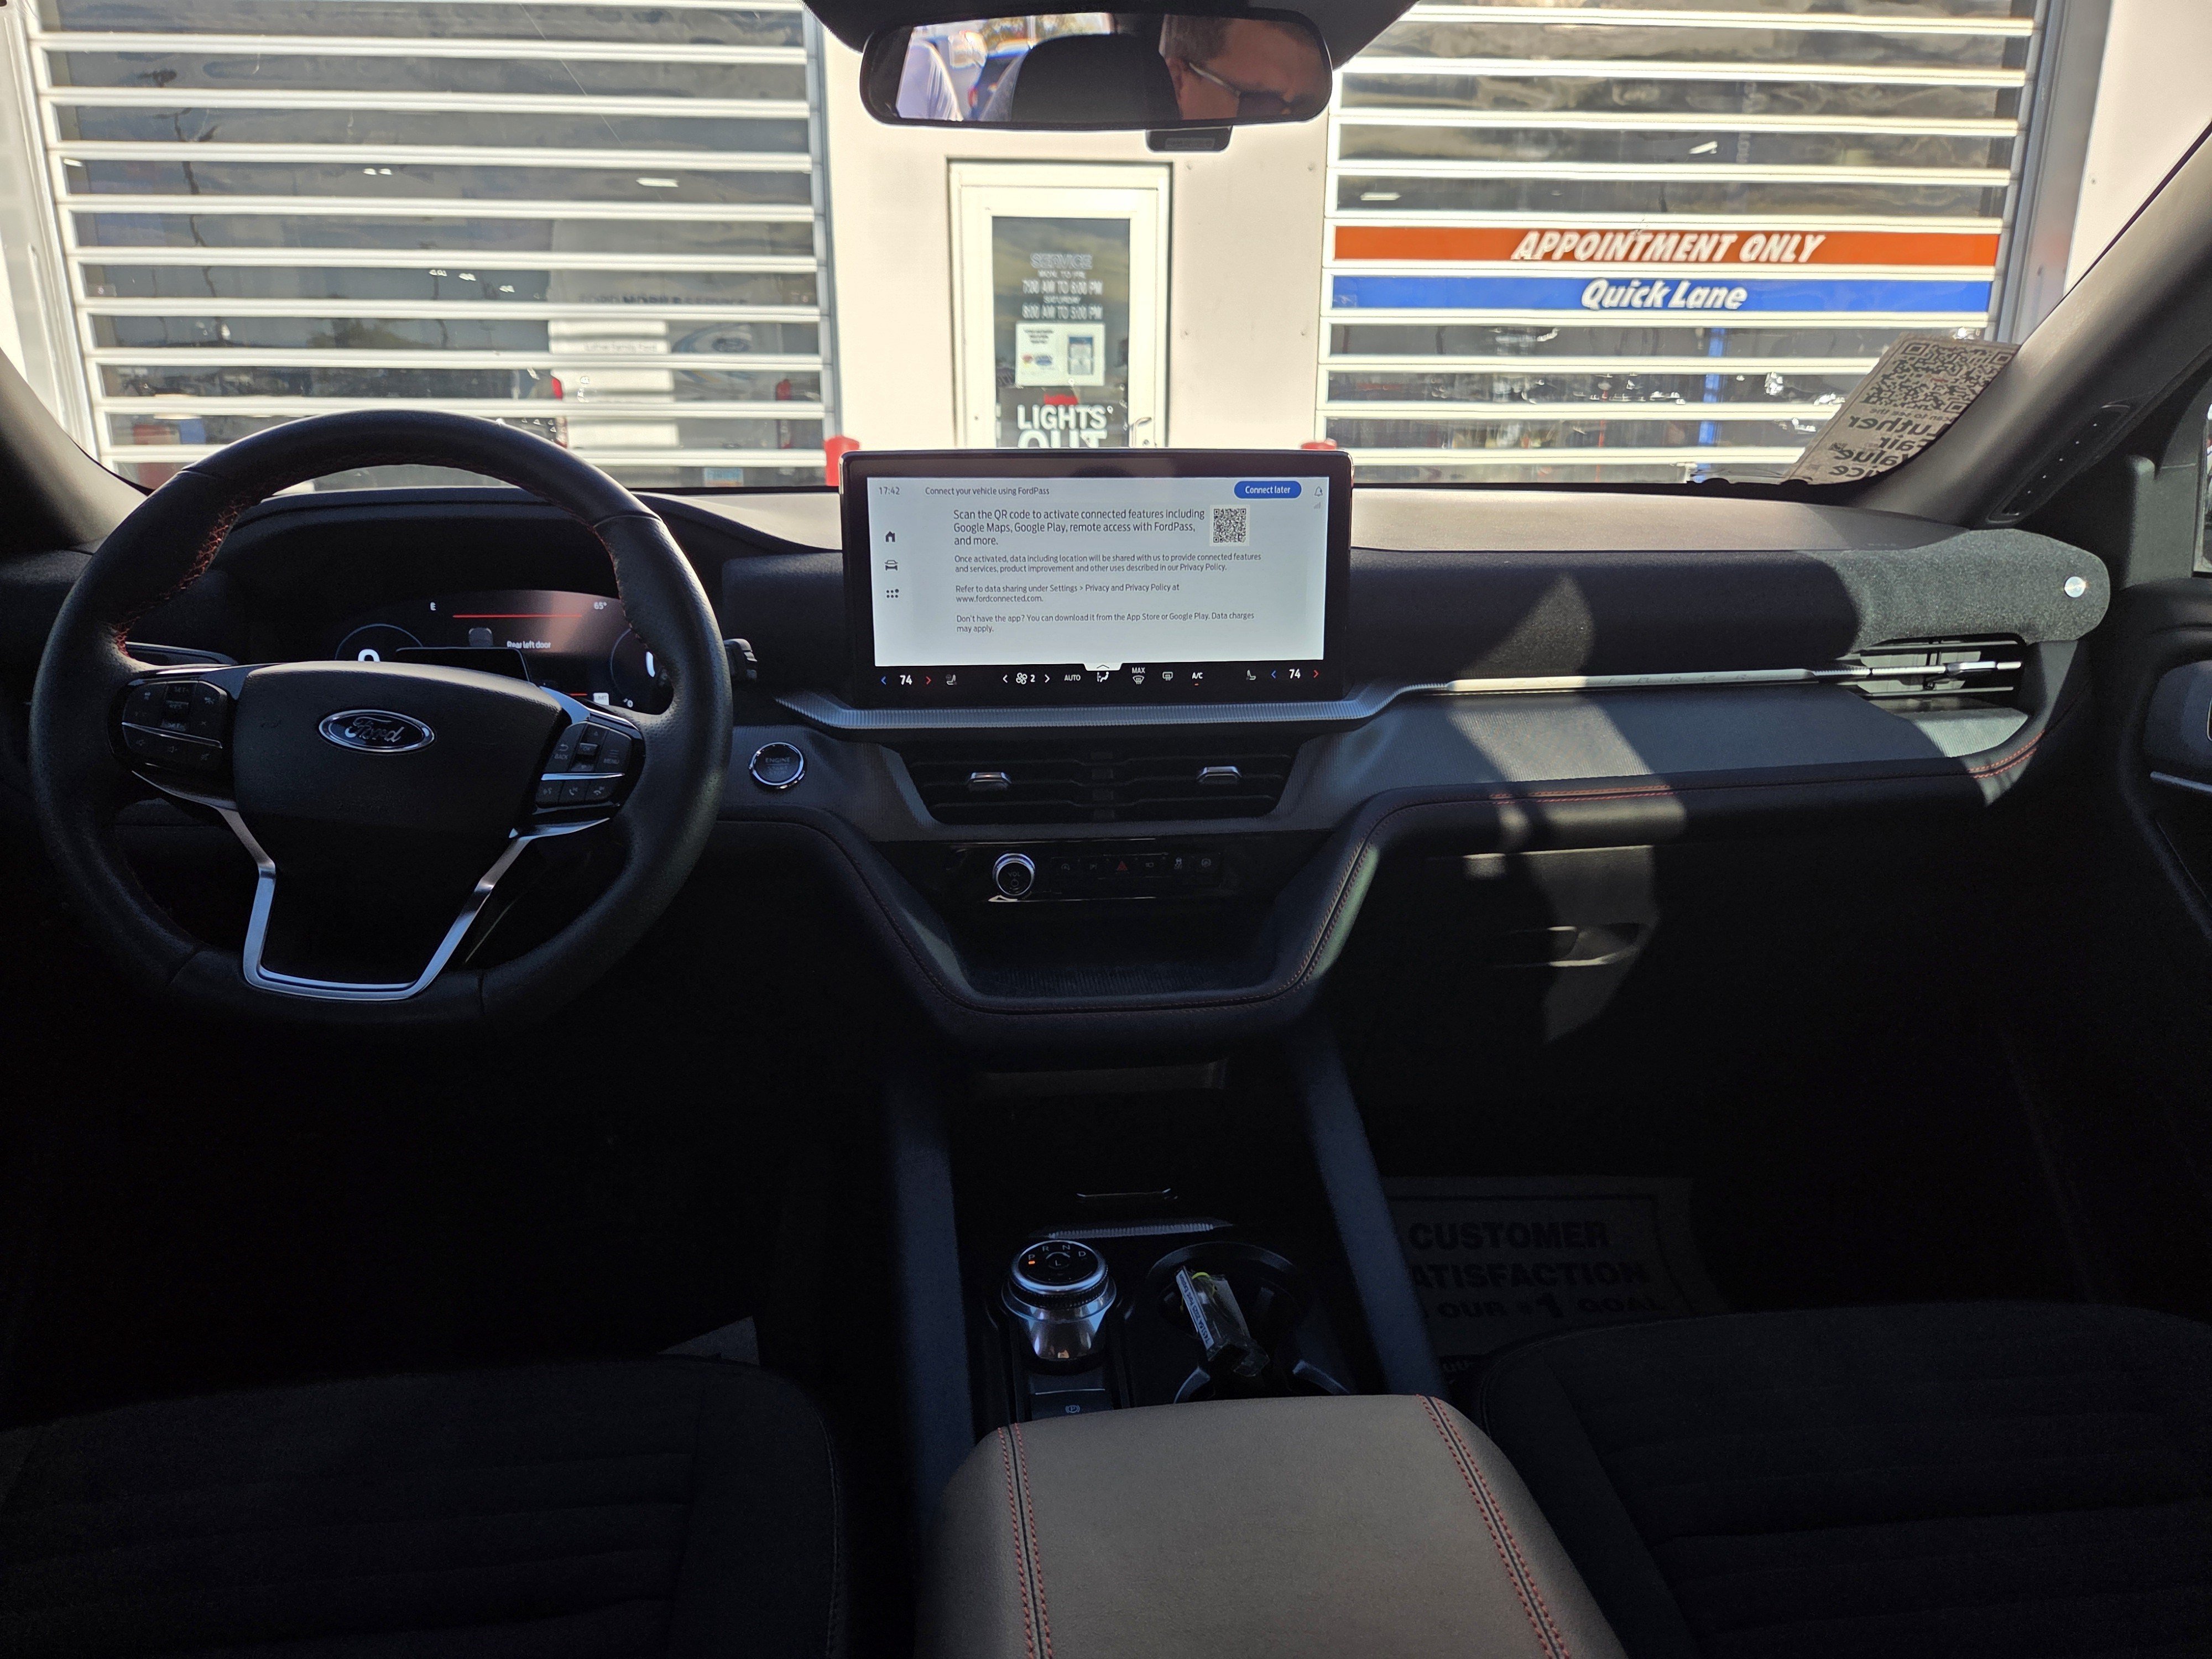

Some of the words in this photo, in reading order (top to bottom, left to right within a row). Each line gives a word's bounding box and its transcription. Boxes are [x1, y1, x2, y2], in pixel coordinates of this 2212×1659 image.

[1511, 231, 1739, 262] APPOINTMENT
[1739, 233, 1825, 262] ONLY
[1030, 253, 1093, 269] SERVICE
[1057, 280, 1070, 294] TO
[1088, 280, 1103, 295] PM
[1582, 278, 1670, 310] Quick
[1668, 281, 1747, 310] Lane
[1057, 305, 1070, 319] TO
[1088, 305, 1103, 319] PM
[1017, 404, 1107, 430] LIGHTS
[879, 487, 900, 495] 17:42
[925, 487, 954, 495] Connect
[953, 509, 975, 519] Scan
[977, 509, 992, 519] the
[994, 509, 1008, 521] QR
[1009, 509, 1030, 519] code
[1032, 510, 1042, 519] to
[1044, 510, 1079, 519] activate
[1081, 509, 1126, 519] connected
[1128, 509, 1164, 519] features
[1166, 509, 1205, 520] including
[953, 522, 984, 534] Google
[987, 523, 1013, 534] Maps,
[1014, 522, 1045, 534] Google
[1047, 522, 1068, 534] Play,
[1070, 523, 1101, 532] remote
[1133, 522, 1152, 531] with
[1154, 522, 1196, 532] FordPass,
[954, 535, 972, 545] and
[973, 555, 1009, 563] activated,
[1027, 555, 1058, 563] including
[1171, 554, 1196, 562] provide
[1197, 552, 1233, 561] connected
[1000, 565, 1026, 573] product
[1027, 565, 1074, 573] improvement
[1180, 564, 1204, 572] Privacy
[1205, 563, 1227, 572] Policy.
[1002, 585, 1027, 594] sharing
[1050, 584, 1078, 593] Settings
[1085, 585, 1110, 593] Privacy
[1125, 583, 1150, 592] Privacy
[1151, 583, 1171, 592] Policy
[1008, 614, 1025, 623] app?
[1169, 613, 1193, 621] Google
[1194, 612, 1210, 620] Play.
[1229, 612, 1255, 620] charges
[973, 625, 994, 633] apply.
[523, 640, 535, 649] left
[535, 640, 551, 649] door
[1030, 674, 1036, 683] 2
[1289, 669, 1301, 679] 74
[900, 675, 912, 685] 74
[344, 716, 405, 743] Ford
[1409, 1220, 1610, 1250] CUSTOMER
[1412, 1261, 1650, 1288] ATISFACTION
[1437, 1300, 1509, 1318] OUR
